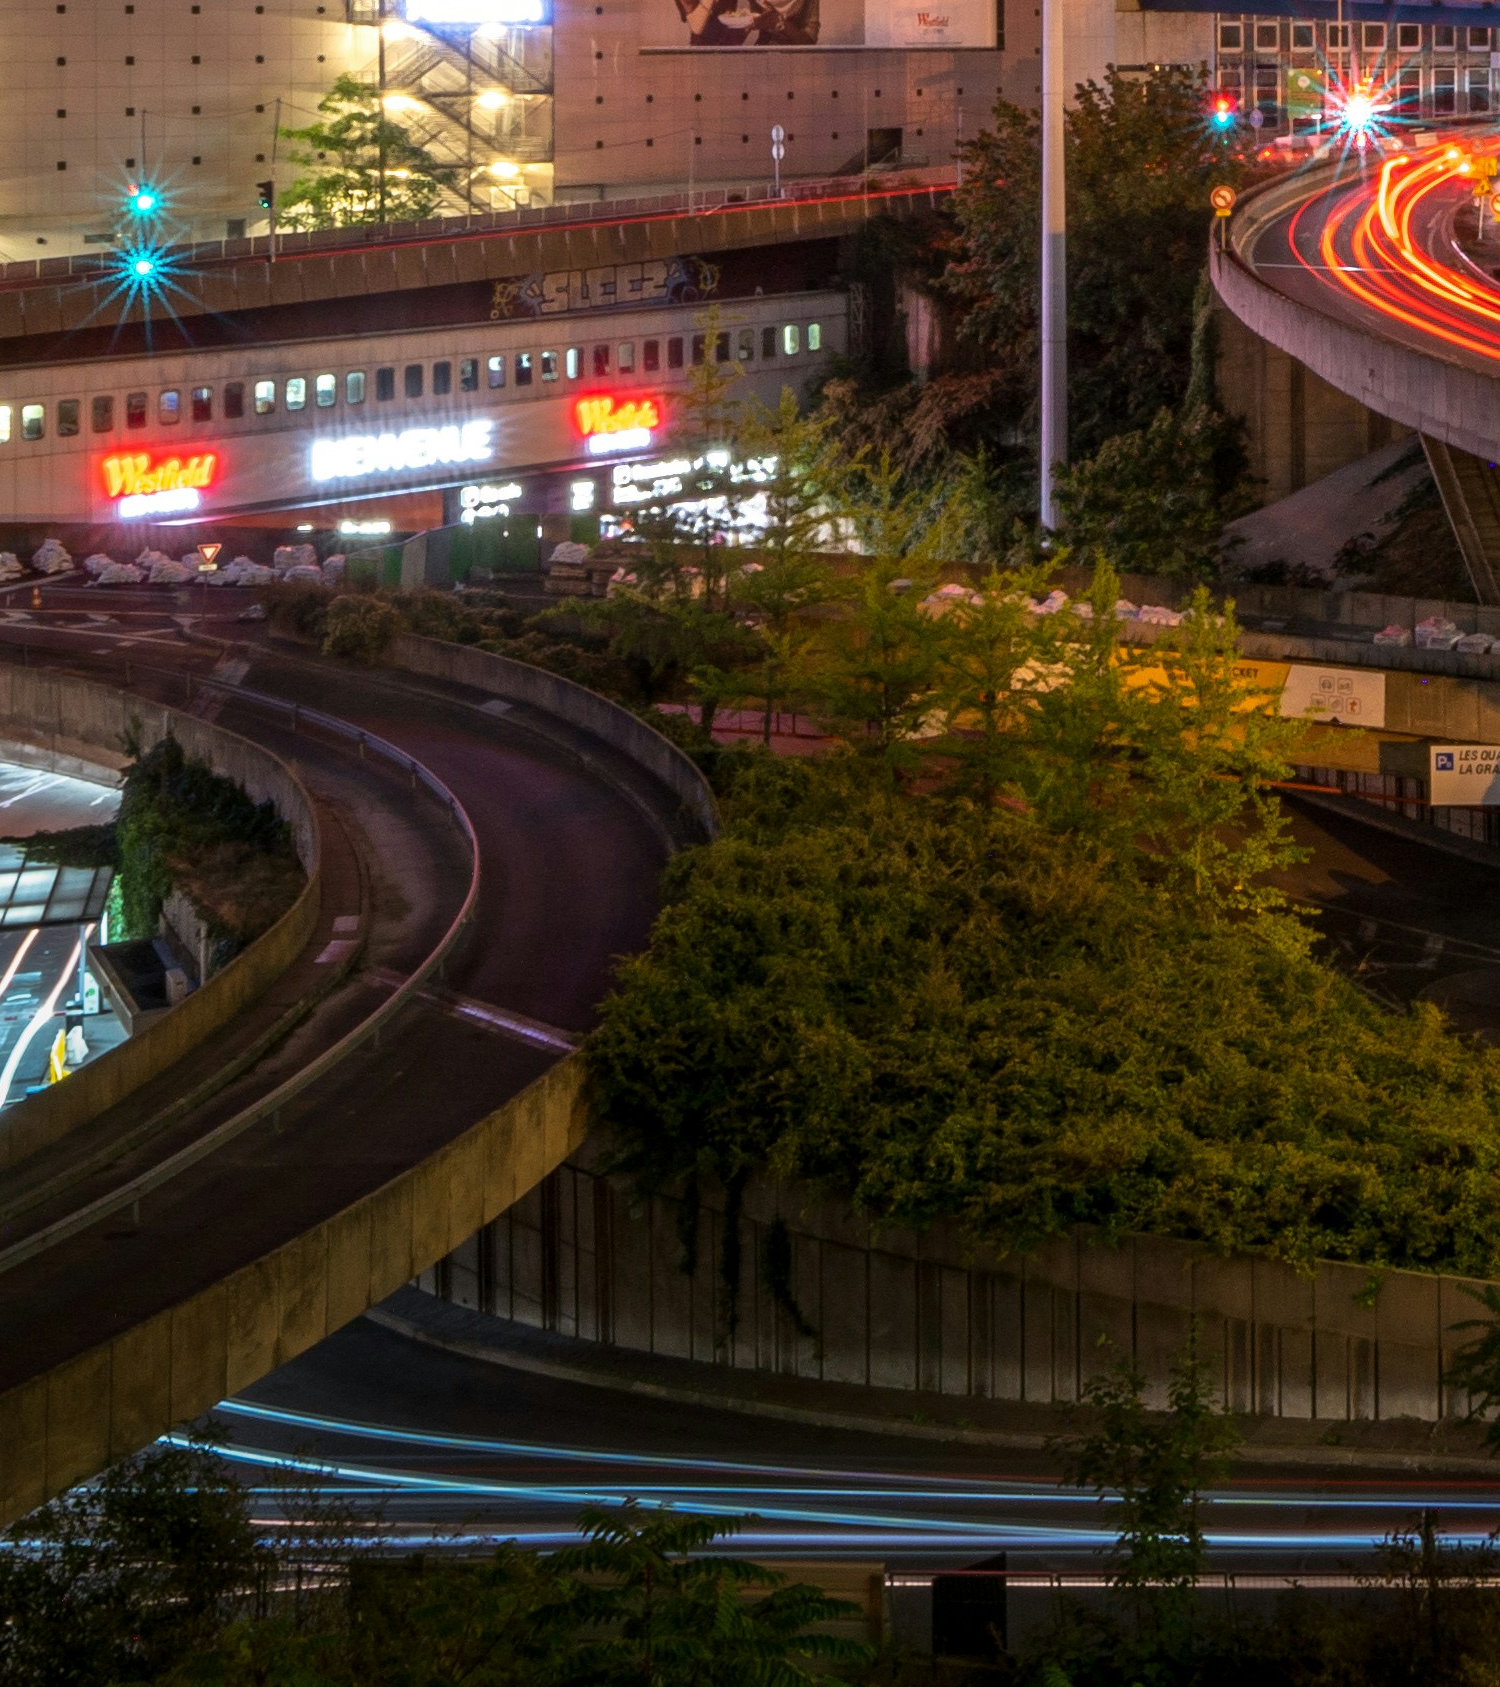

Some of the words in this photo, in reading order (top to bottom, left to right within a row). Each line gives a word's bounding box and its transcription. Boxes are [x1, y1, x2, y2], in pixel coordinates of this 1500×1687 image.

[103, 454, 216, 498] Westfield
[1459, 750, 1478, 761] LES
[1459, 763, 1473, 775] LA
